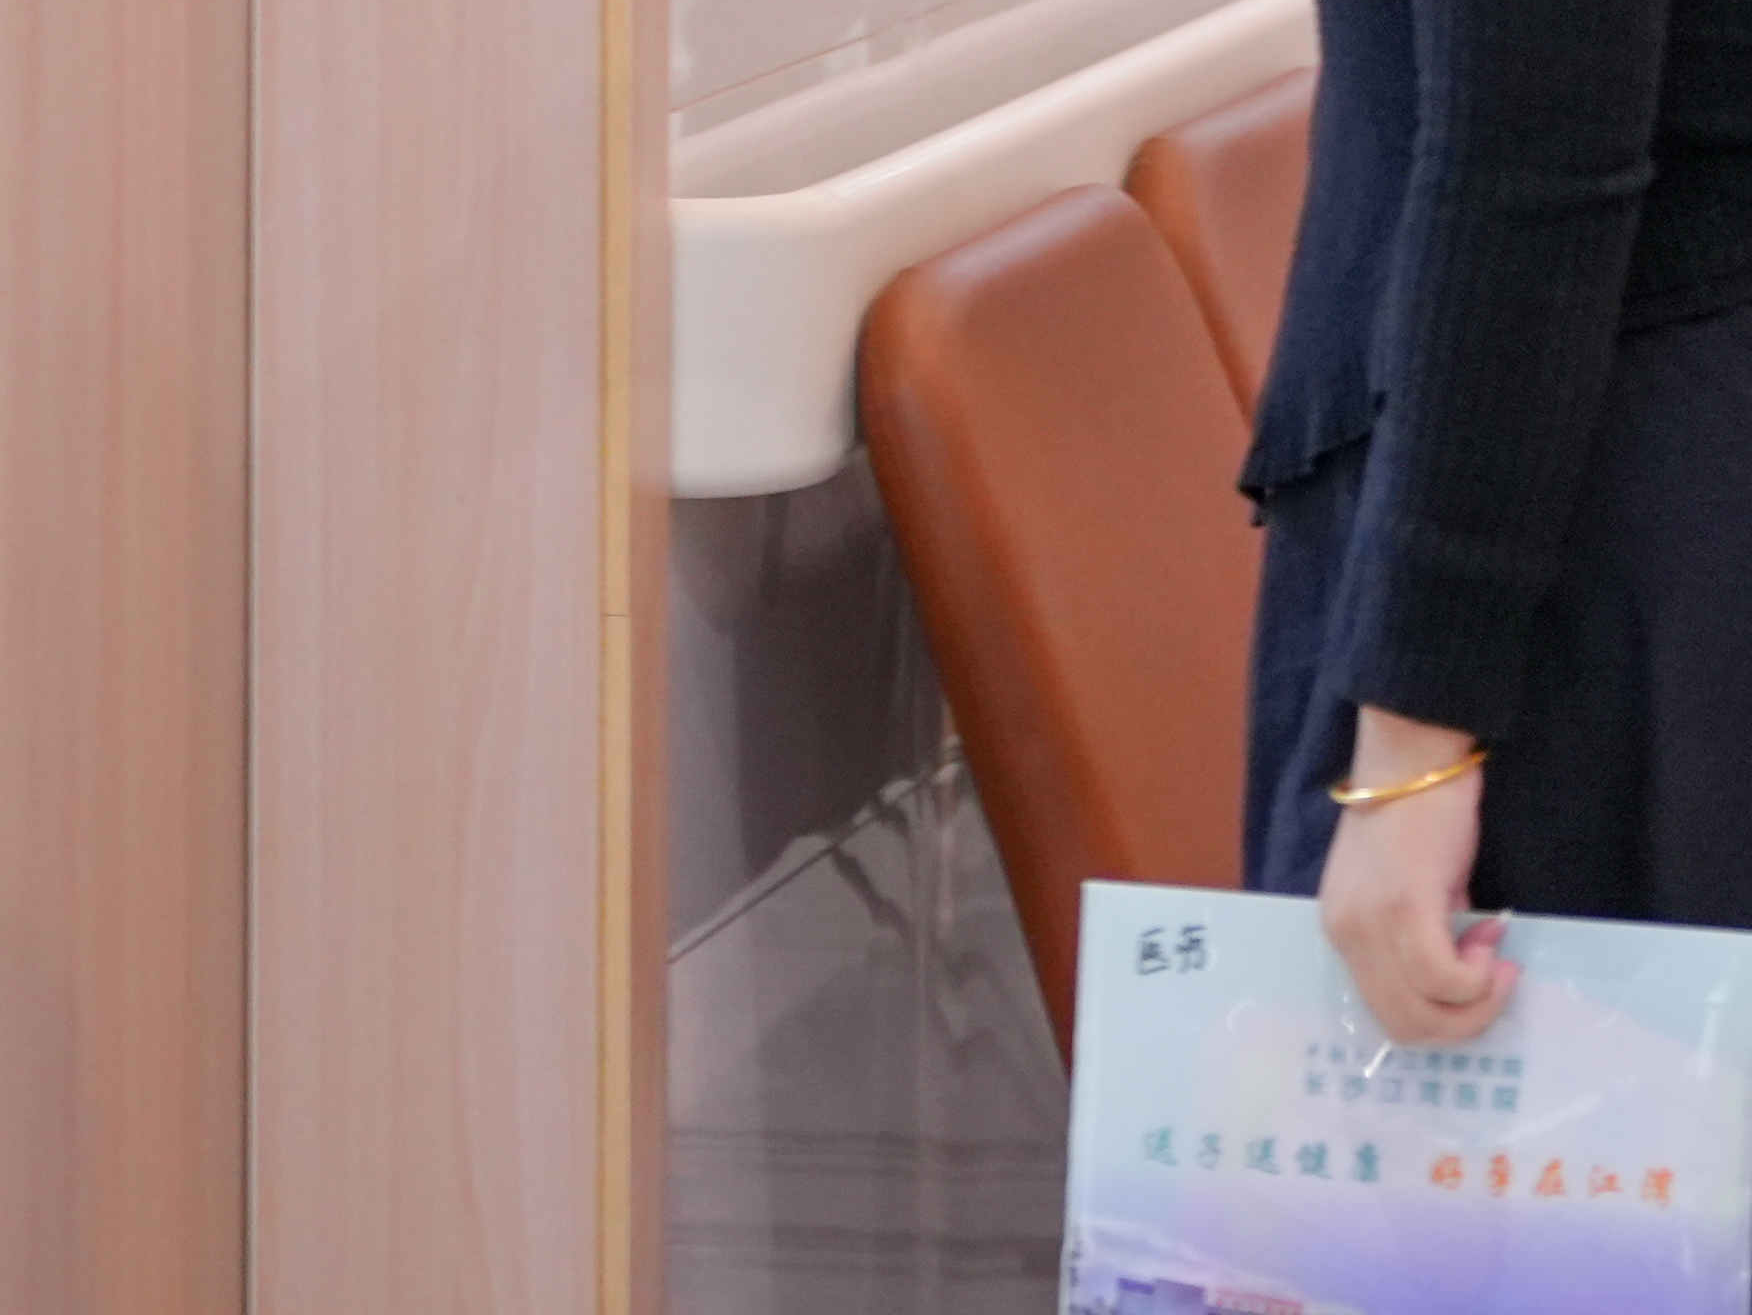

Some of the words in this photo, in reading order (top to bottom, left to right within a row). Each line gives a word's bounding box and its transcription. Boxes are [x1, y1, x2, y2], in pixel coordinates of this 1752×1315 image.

[1304, 1072, 1520, 1114] 长沙江湾医院
[1144, 1126, 1382, 1184] 送子送健康
[1430, 1151, 1676, 1210] 好孕在江湾
